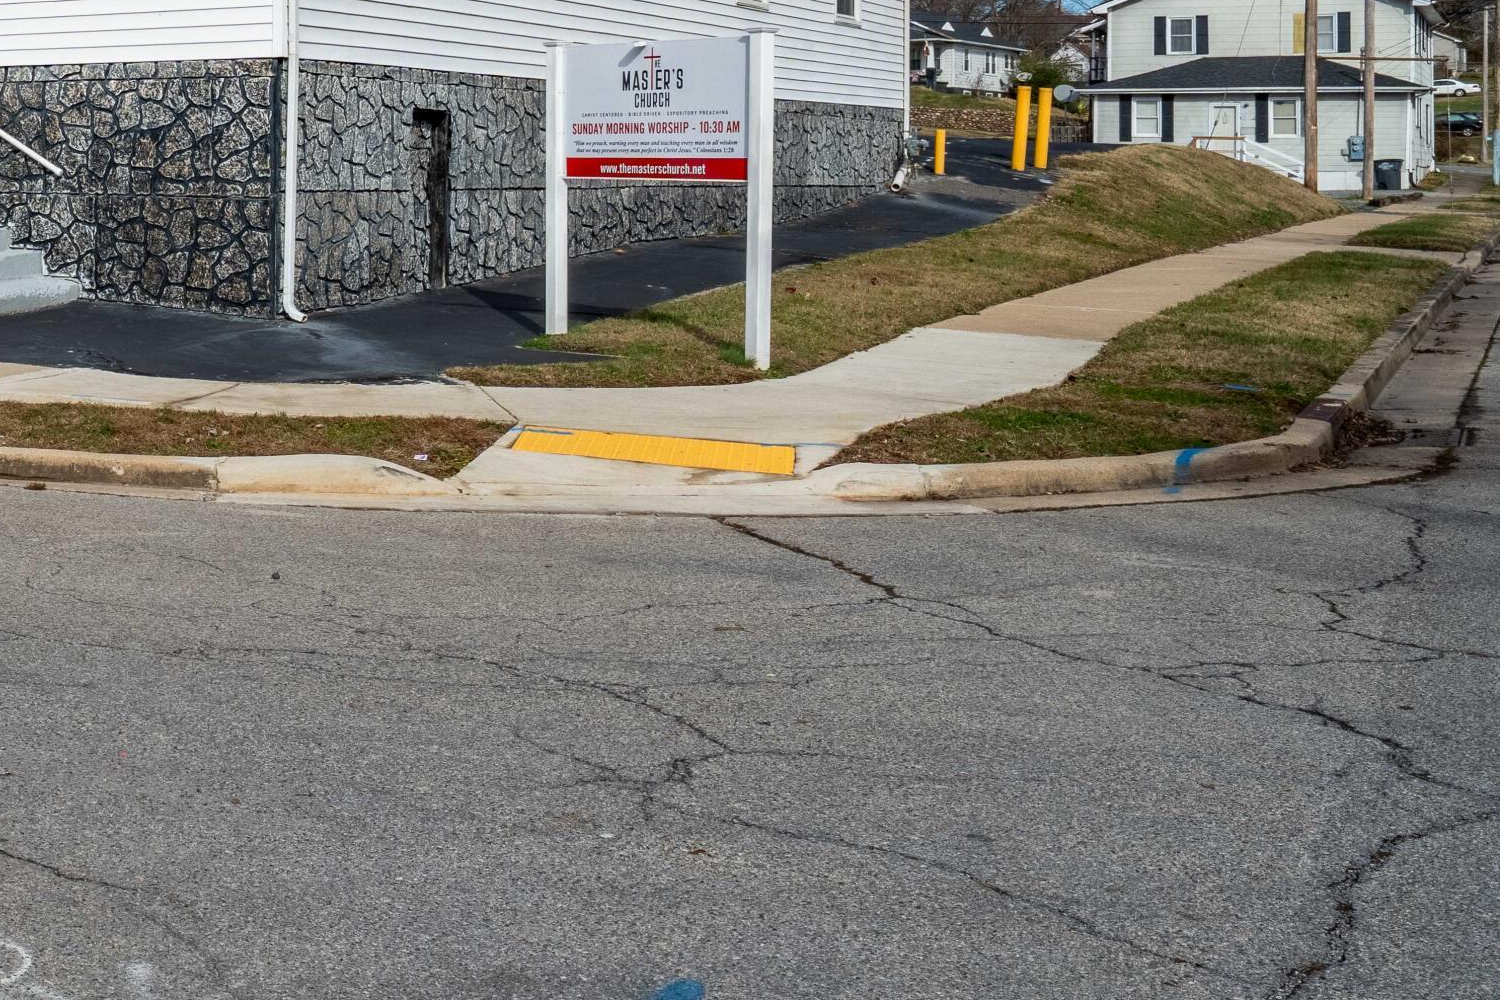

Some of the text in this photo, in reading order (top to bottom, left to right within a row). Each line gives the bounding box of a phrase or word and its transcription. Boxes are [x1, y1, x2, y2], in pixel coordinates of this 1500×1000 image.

[622, 68, 684, 91] MASTER'S
[634, 92, 670, 108] CHURCH
[572, 122, 604, 135] SUNDAY
[606, 122, 645, 135] MORNING
[647, 121, 689, 134] WORSHIP
[699, 120, 724, 134] 10:30
[726, 120, 740, 133] AM
[600, 163, 706, 175] www.themasterschurch.net
